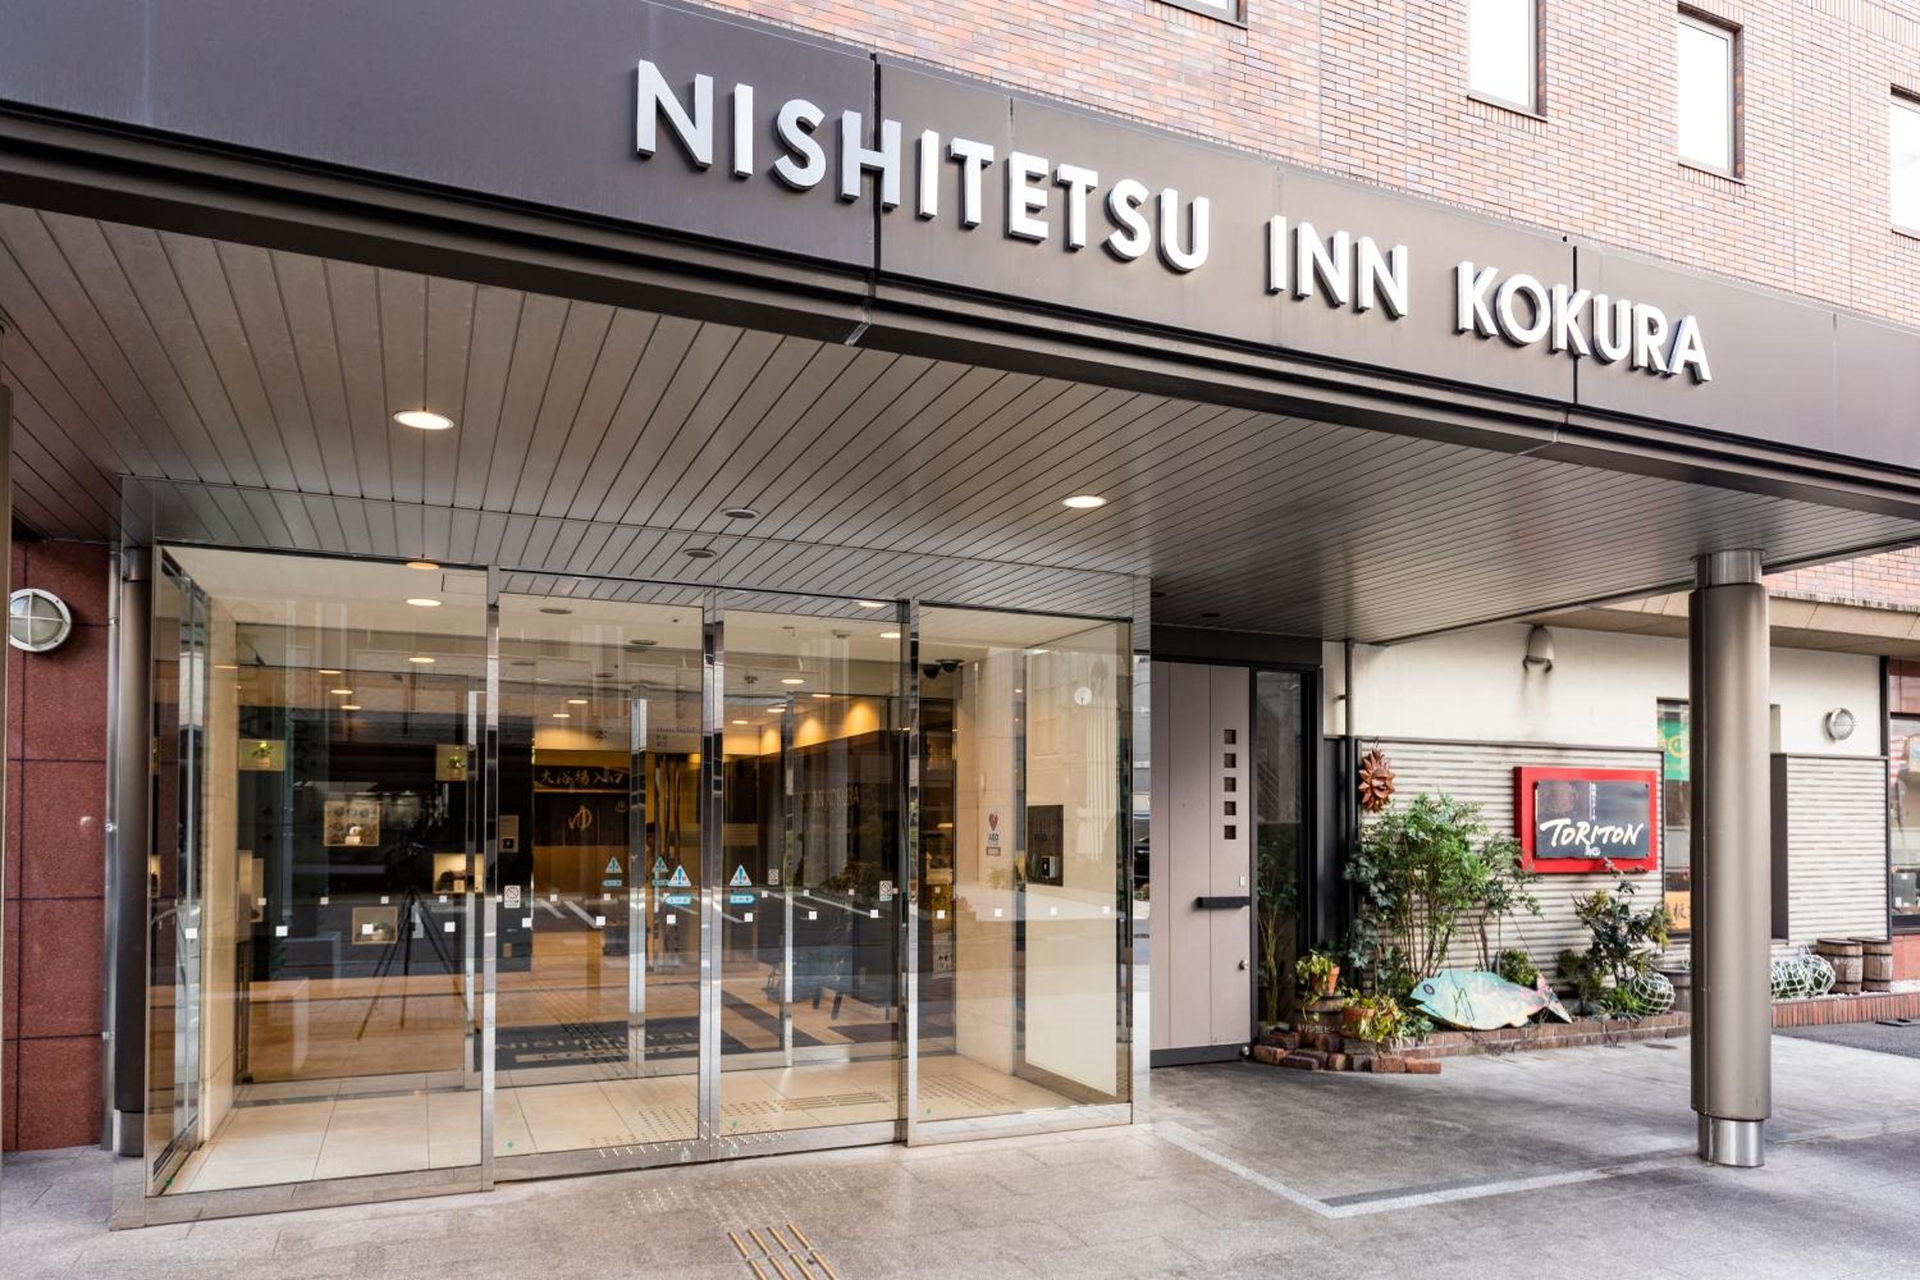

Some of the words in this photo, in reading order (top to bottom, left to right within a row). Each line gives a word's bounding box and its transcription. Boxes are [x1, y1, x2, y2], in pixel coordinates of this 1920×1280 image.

[636, 59, 1209, 272] NISHITETSU
[1267, 215, 1408, 318] INN
[1456, 261, 1712, 383] KOKURA
[540, 768, 624, 786] 大浴場入口
[567, 804, 593, 831] ゆ
[1539, 818, 1644, 847] TORITON
